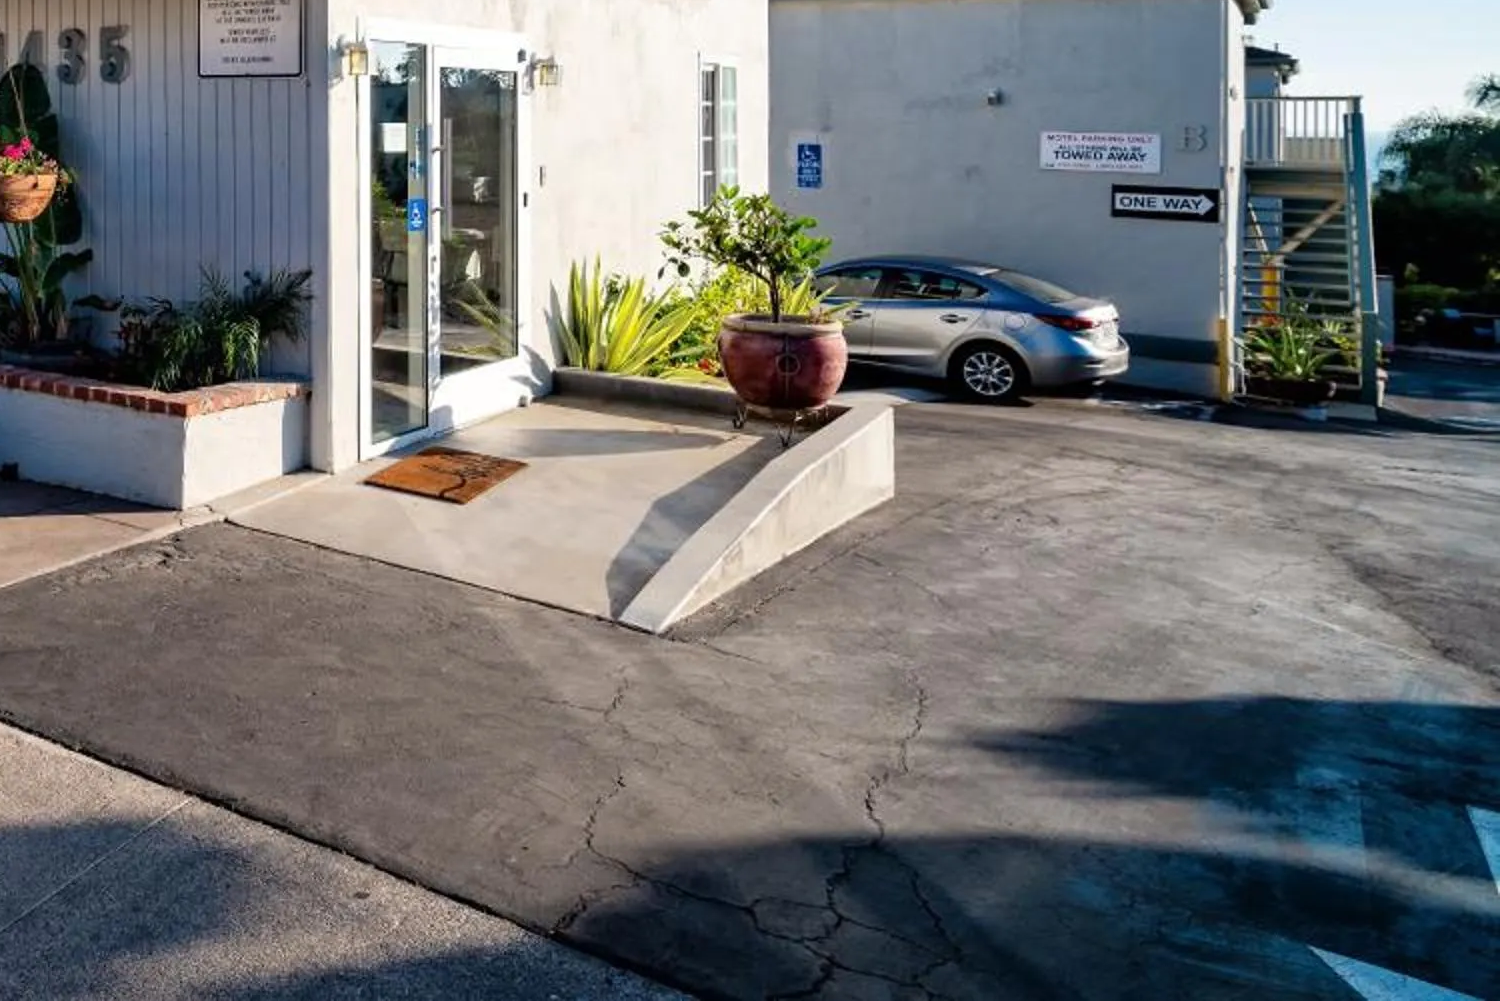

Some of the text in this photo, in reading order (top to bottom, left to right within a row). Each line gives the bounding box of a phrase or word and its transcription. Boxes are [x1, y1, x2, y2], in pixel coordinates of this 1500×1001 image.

[1053, 150, 1148, 162] TOWED AWAY
[1119, 195, 1203, 211] ONE WAY
